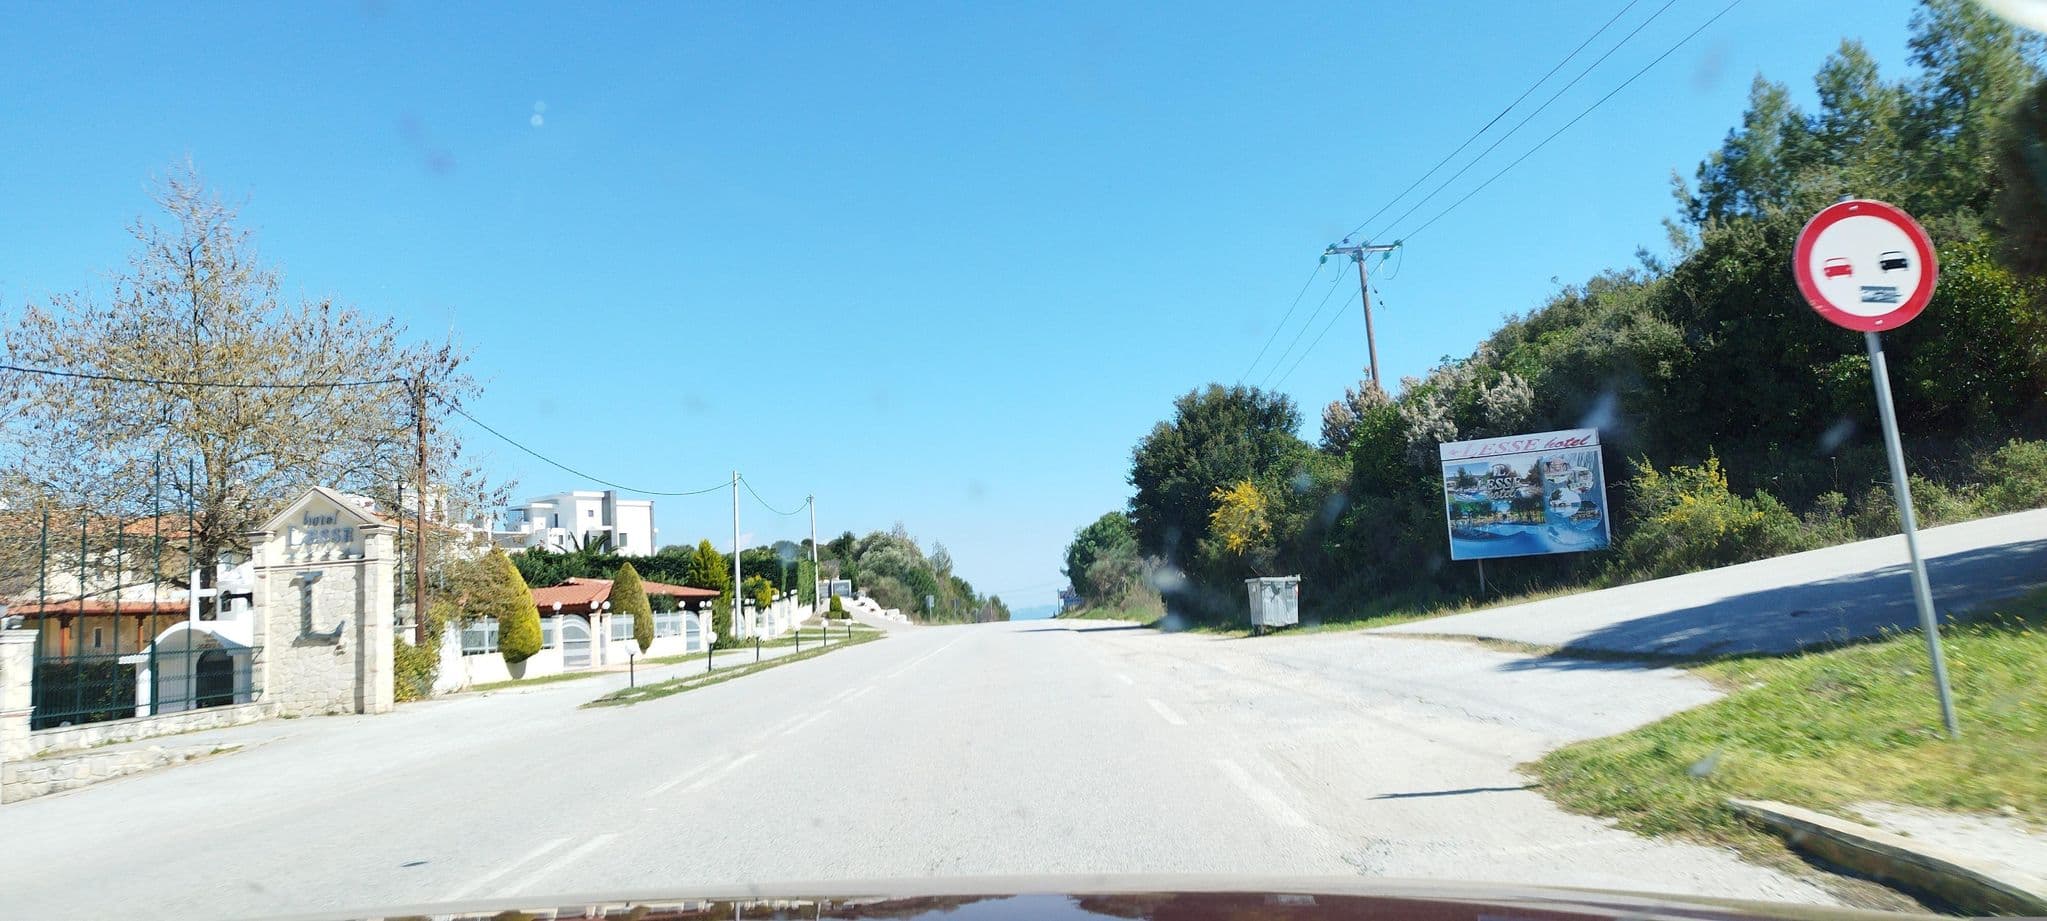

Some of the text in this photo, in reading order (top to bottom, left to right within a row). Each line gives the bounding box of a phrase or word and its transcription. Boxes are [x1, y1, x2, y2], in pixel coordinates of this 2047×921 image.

[1463, 434, 1591, 457] LESSE hotel
[304, 509, 340, 526] hotel
[287, 526, 353, 546] LESSE
[294, 571, 345, 646] L
